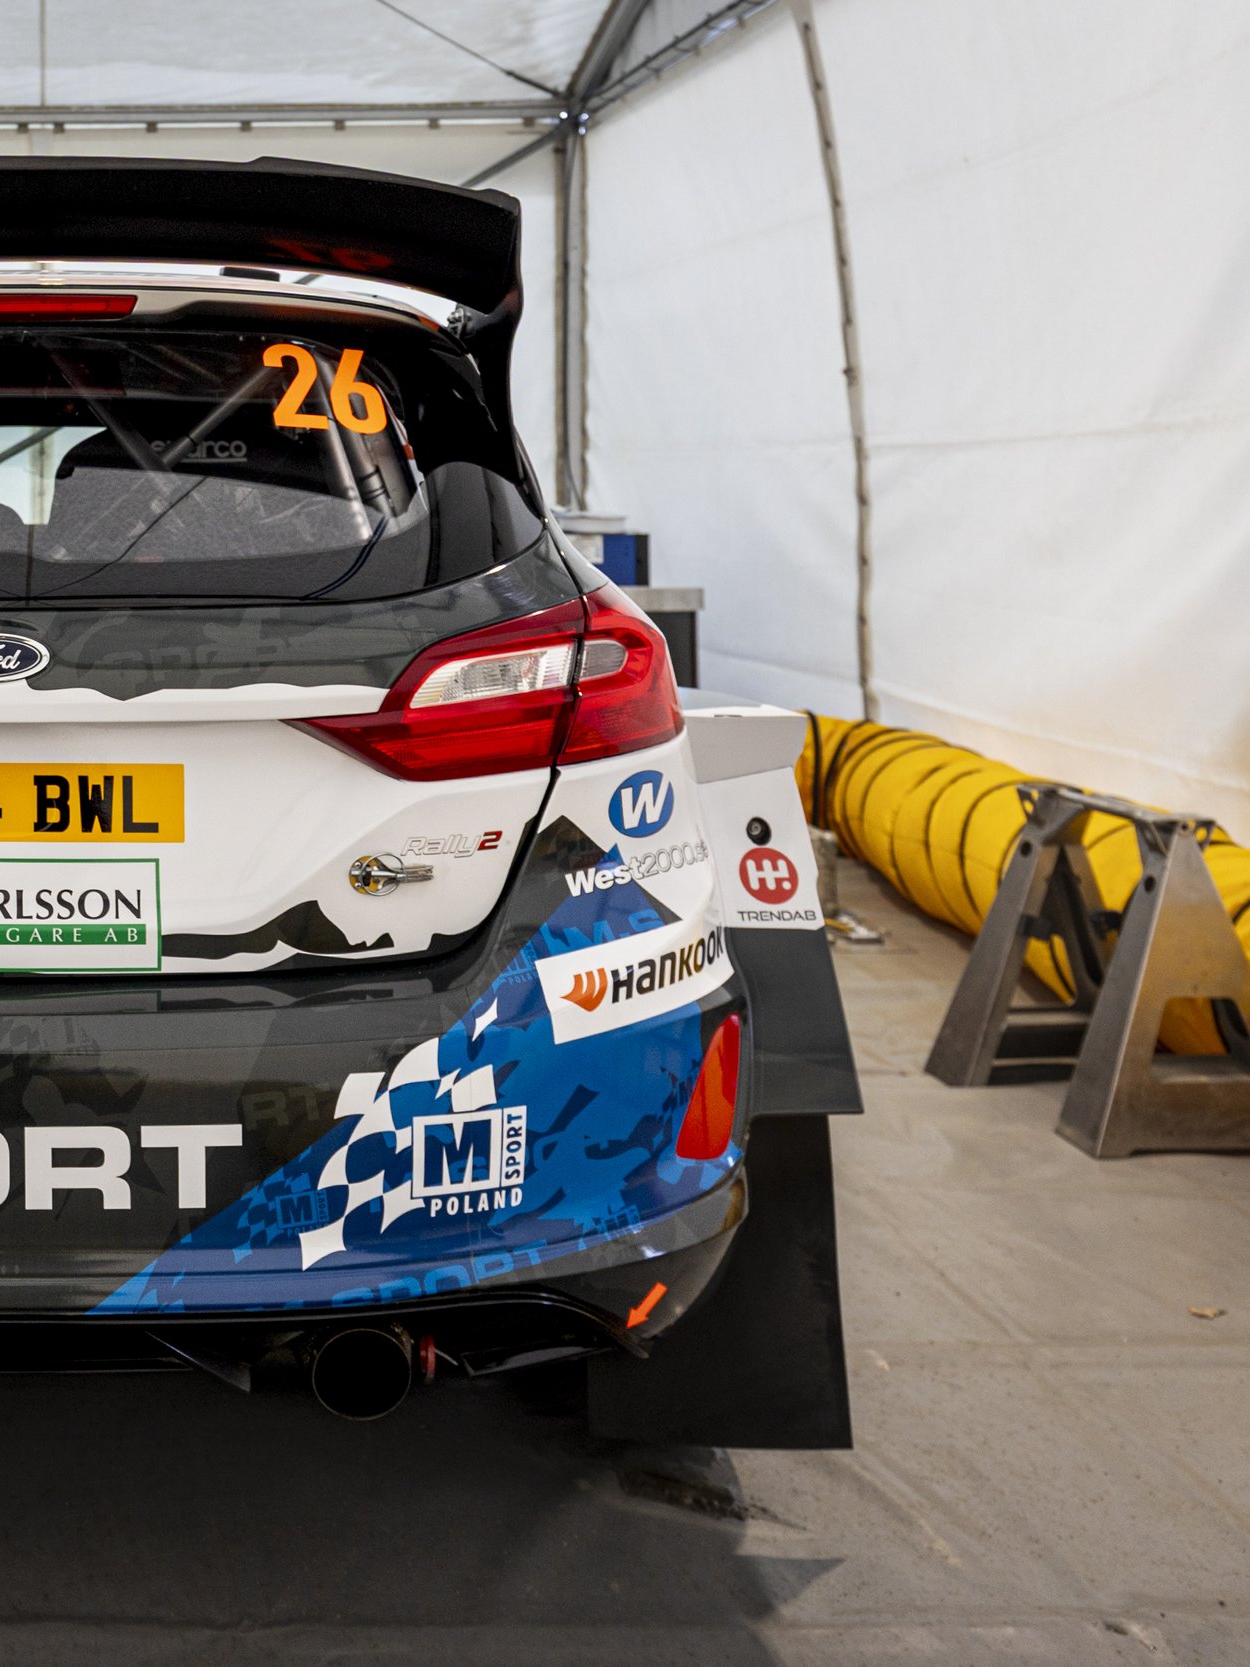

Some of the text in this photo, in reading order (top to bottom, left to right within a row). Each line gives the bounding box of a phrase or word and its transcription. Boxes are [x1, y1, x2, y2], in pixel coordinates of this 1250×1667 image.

[261, 343, 387, 435] 26
[33, 775, 159, 833] BWL
[105, 927, 139, 943] AB
[737, 911, 817, 922] TRENDAB
[424, 1119, 492, 1188] M
[505, 1113, 524, 1181] SPORT
[429, 1187, 524, 1218] POLAND
